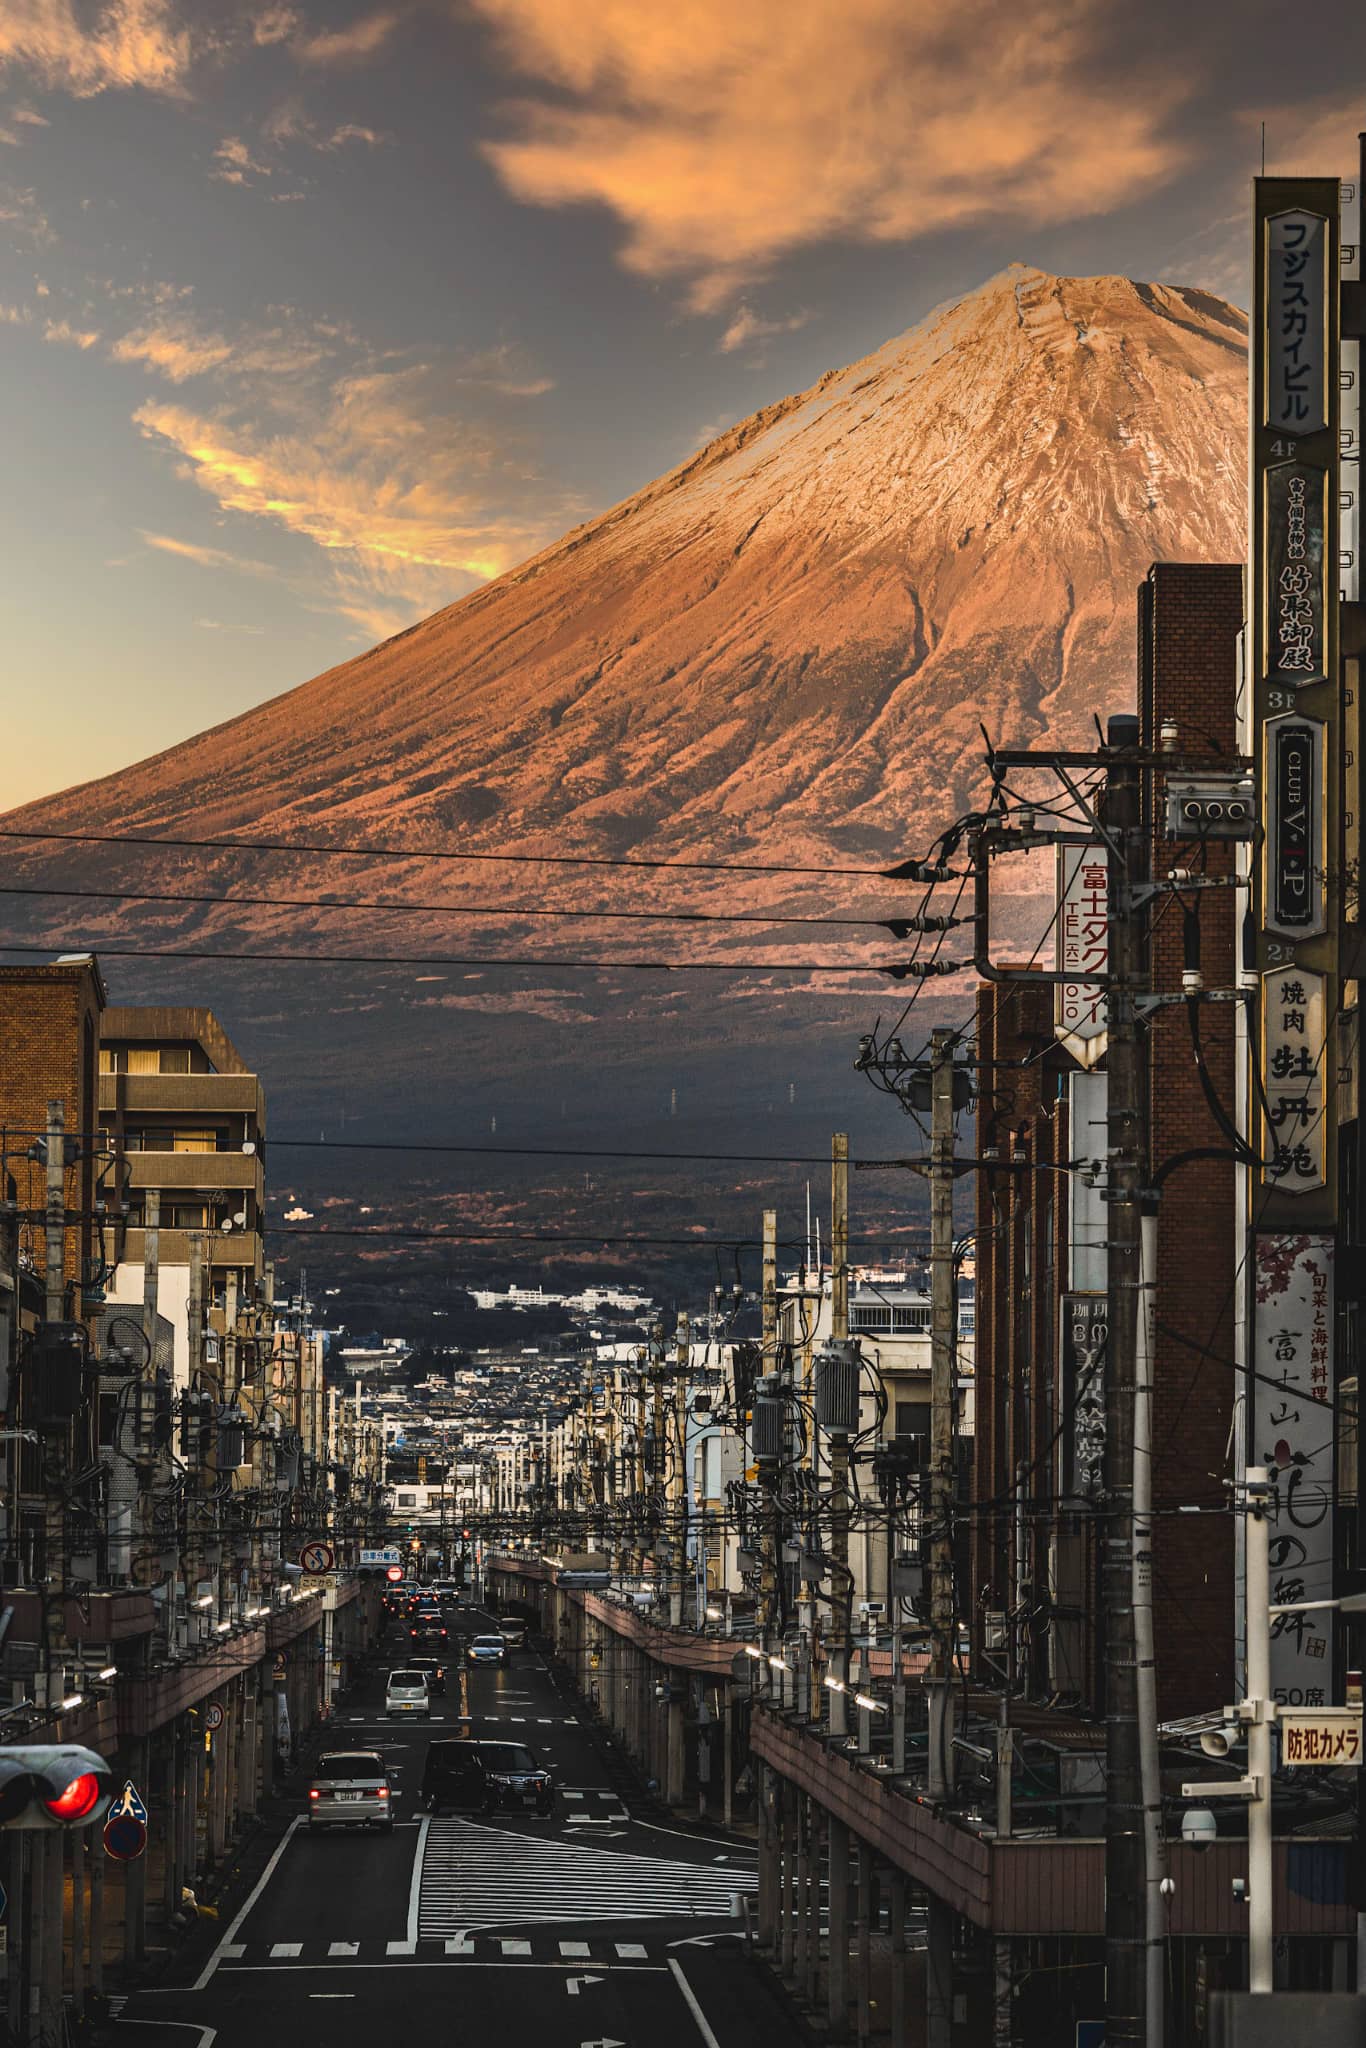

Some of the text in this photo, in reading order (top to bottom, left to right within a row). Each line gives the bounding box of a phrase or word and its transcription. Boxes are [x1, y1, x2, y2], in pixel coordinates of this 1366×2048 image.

[1281, 224, 1311, 420] フジスカイビル
[1270, 440, 1296, 457] 4F
[1268, 692, 1296, 708] 3F
[1288, 751, 1301, 803] CLUB
[1081, 862, 1108, 1023] 富士タクシー
[1267, 944, 1295, 961] 2F
[1310, 1273, 1328, 1401] 旬菜と海鮮料理
[302, 1577, 333, 1587] ここから
[1287, 1728, 1360, 1760] 防犯カメラ
